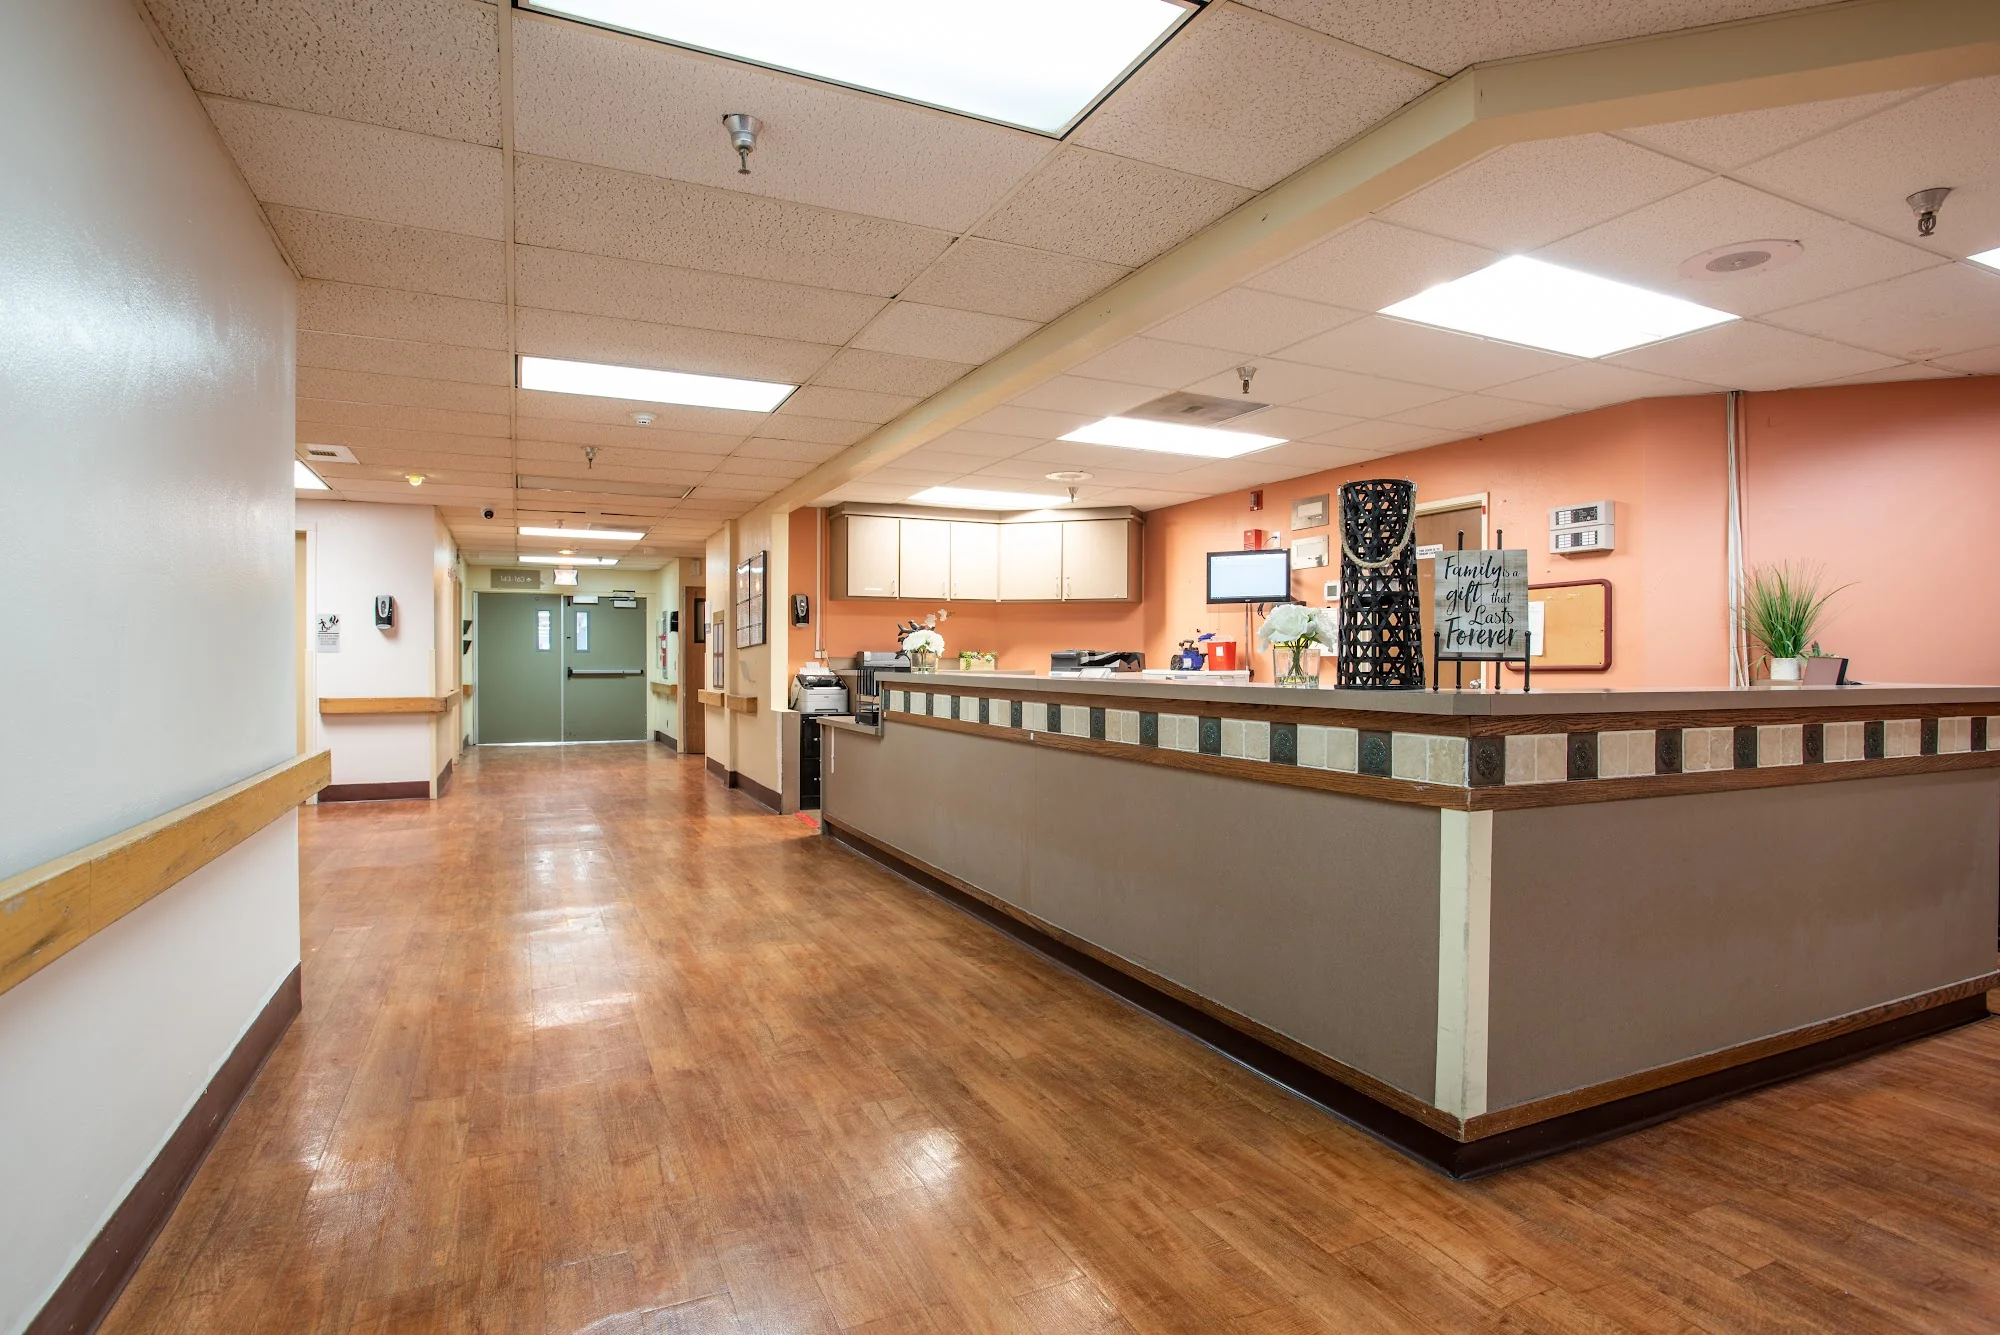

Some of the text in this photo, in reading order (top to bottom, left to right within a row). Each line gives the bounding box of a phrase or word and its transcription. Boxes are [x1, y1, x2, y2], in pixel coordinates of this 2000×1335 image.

[1444, 555, 1502, 588] Family
[1503, 569, 1510, 577] is
[1446, 580, 1512, 616] gift that
[1469, 604, 1514, 625] Lasts
[1444, 616, 1518, 649] Forever
